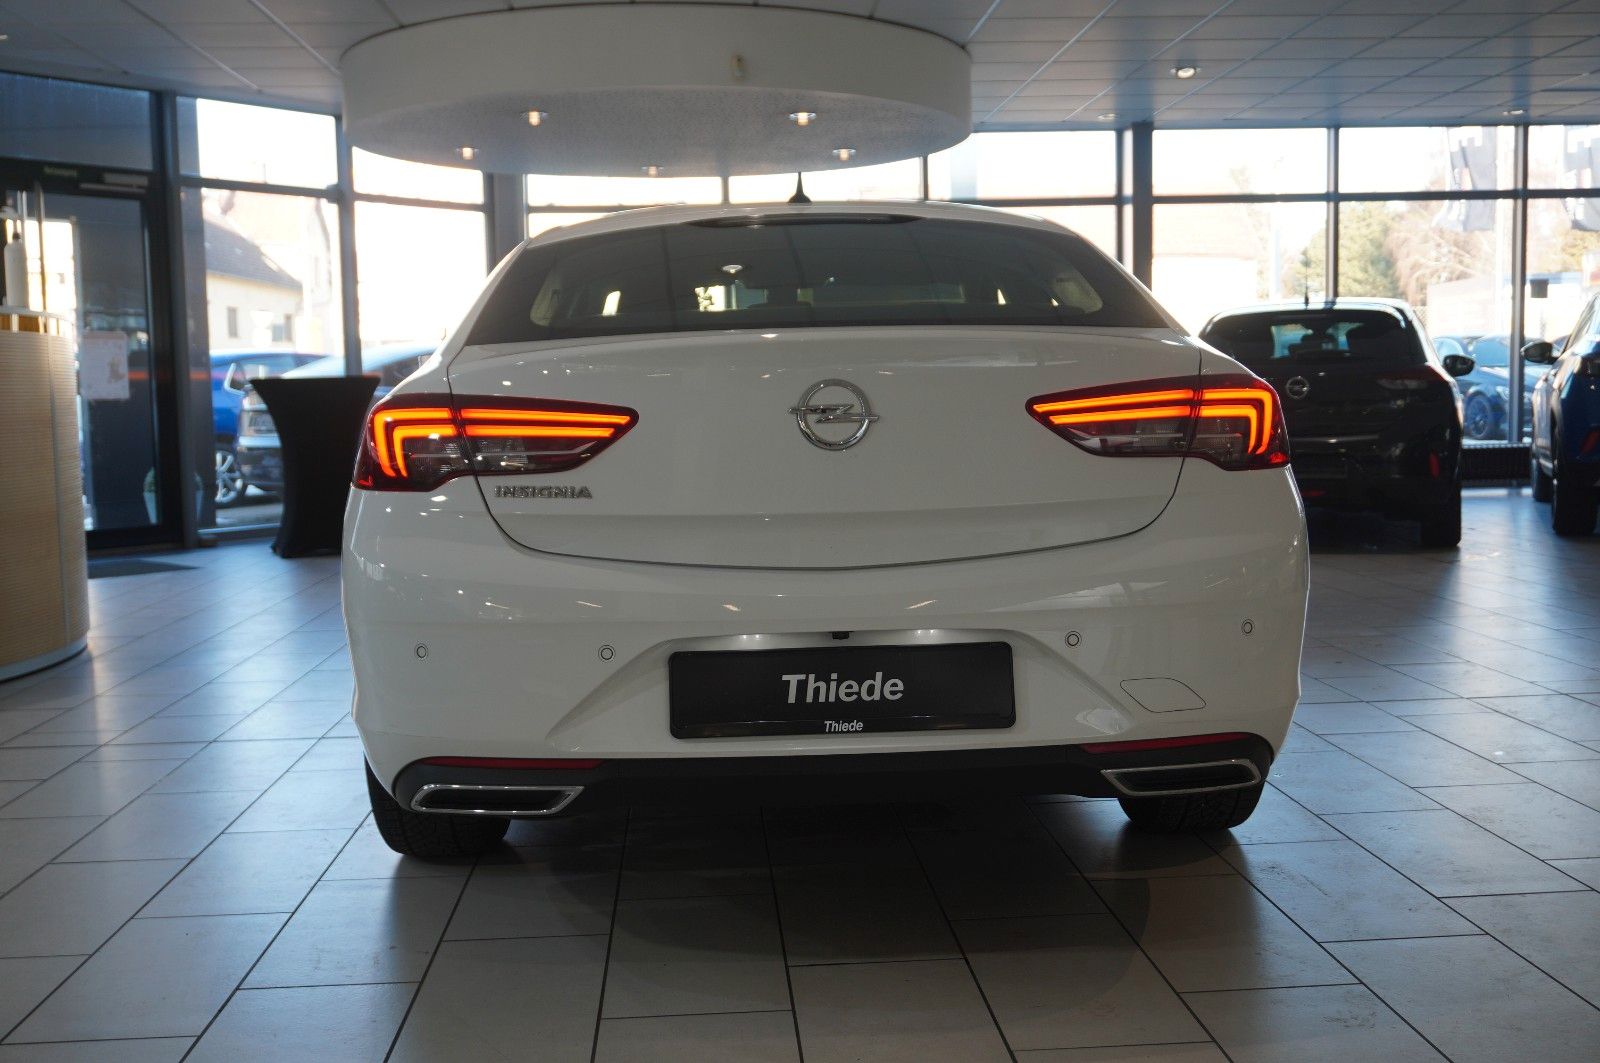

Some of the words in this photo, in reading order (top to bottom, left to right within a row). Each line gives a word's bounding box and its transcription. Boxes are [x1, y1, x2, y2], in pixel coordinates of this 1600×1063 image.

[494, 485, 592, 499] INSIGNIA
[781, 671, 905, 704] Thiede
[823, 719, 864, 733] Thiede
